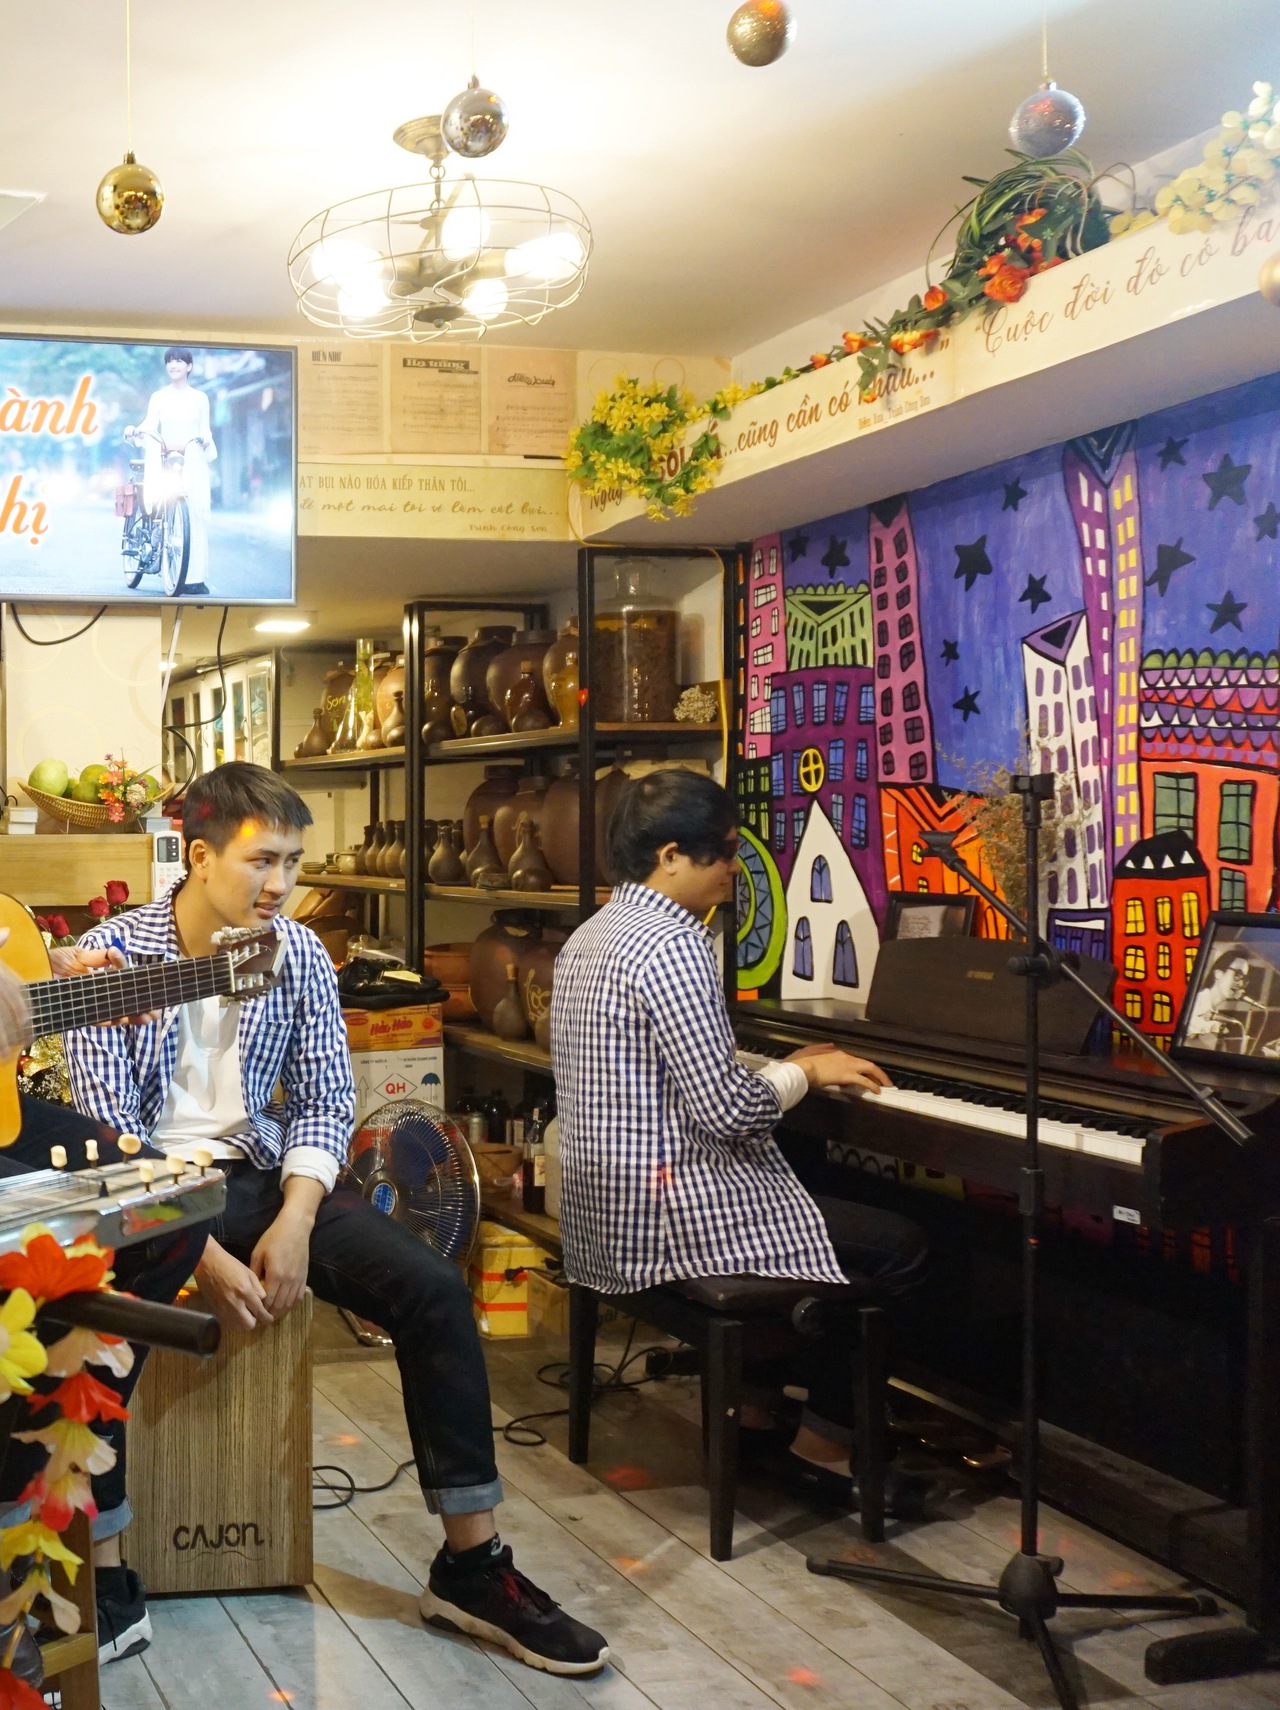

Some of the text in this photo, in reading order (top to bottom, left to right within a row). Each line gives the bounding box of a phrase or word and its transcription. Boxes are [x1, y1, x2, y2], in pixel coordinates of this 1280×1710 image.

[1064, 273, 1115, 320] đời
[1180, 238, 1219, 277] có
[786, 394, 823, 433] cần
[828, 381, 852, 417] có
[318, 476, 335, 492] BỤI
[340, 474, 361, 490] NÀO
[366, 474, 388, 490] HÓA
[392, 474, 413, 491] KIẾP
[419, 475, 446, 491] THÂN
[385, 1082, 406, 1095] QH
